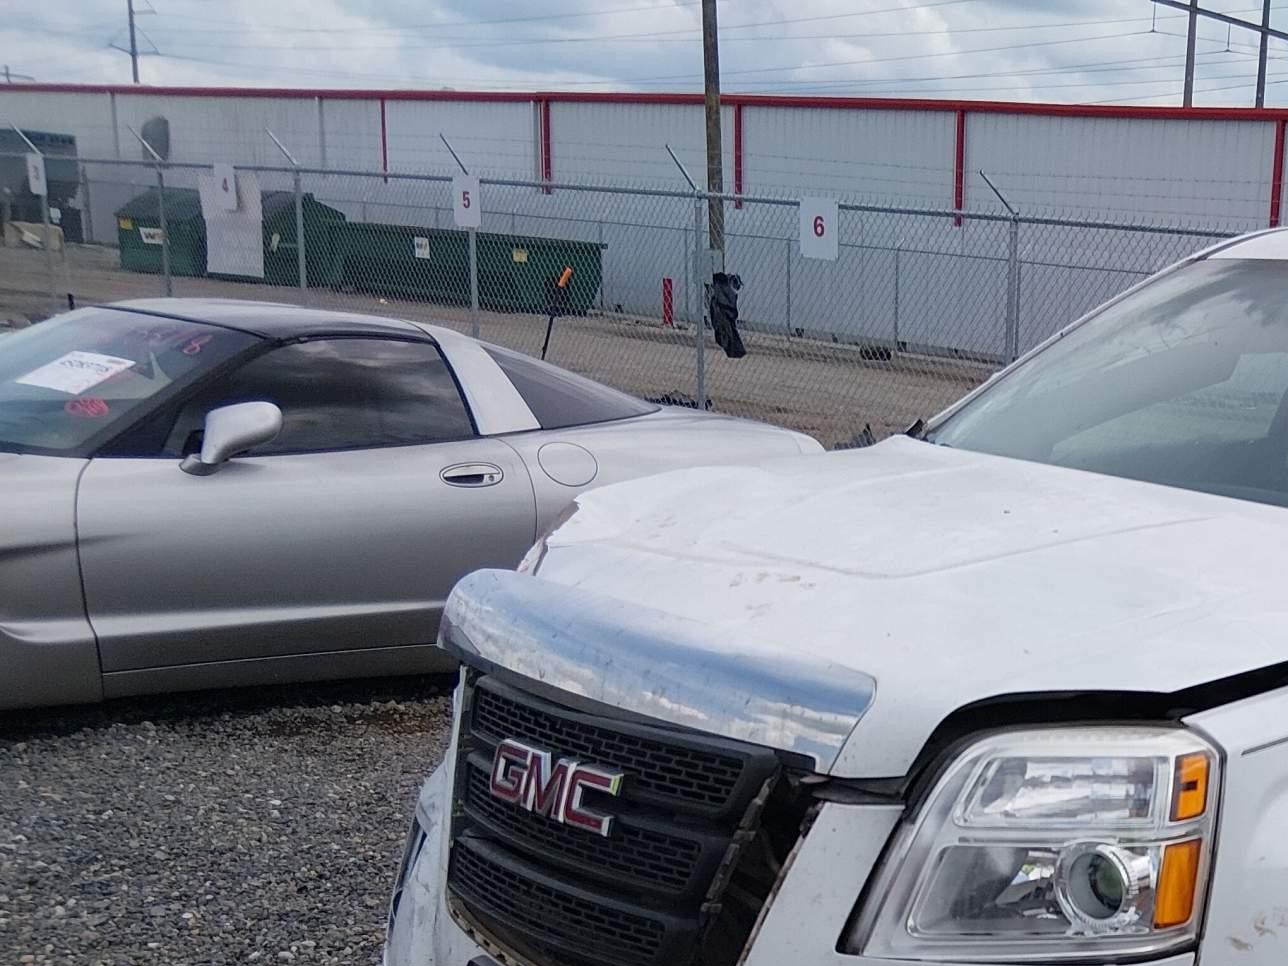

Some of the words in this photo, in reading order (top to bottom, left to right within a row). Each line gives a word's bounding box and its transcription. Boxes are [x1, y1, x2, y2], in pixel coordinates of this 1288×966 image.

[222, 177, 229, 192] 4
[462, 191, 471, 208] 5
[814, 215, 825, 237] 6
[489, 738, 625, 837] GMC
